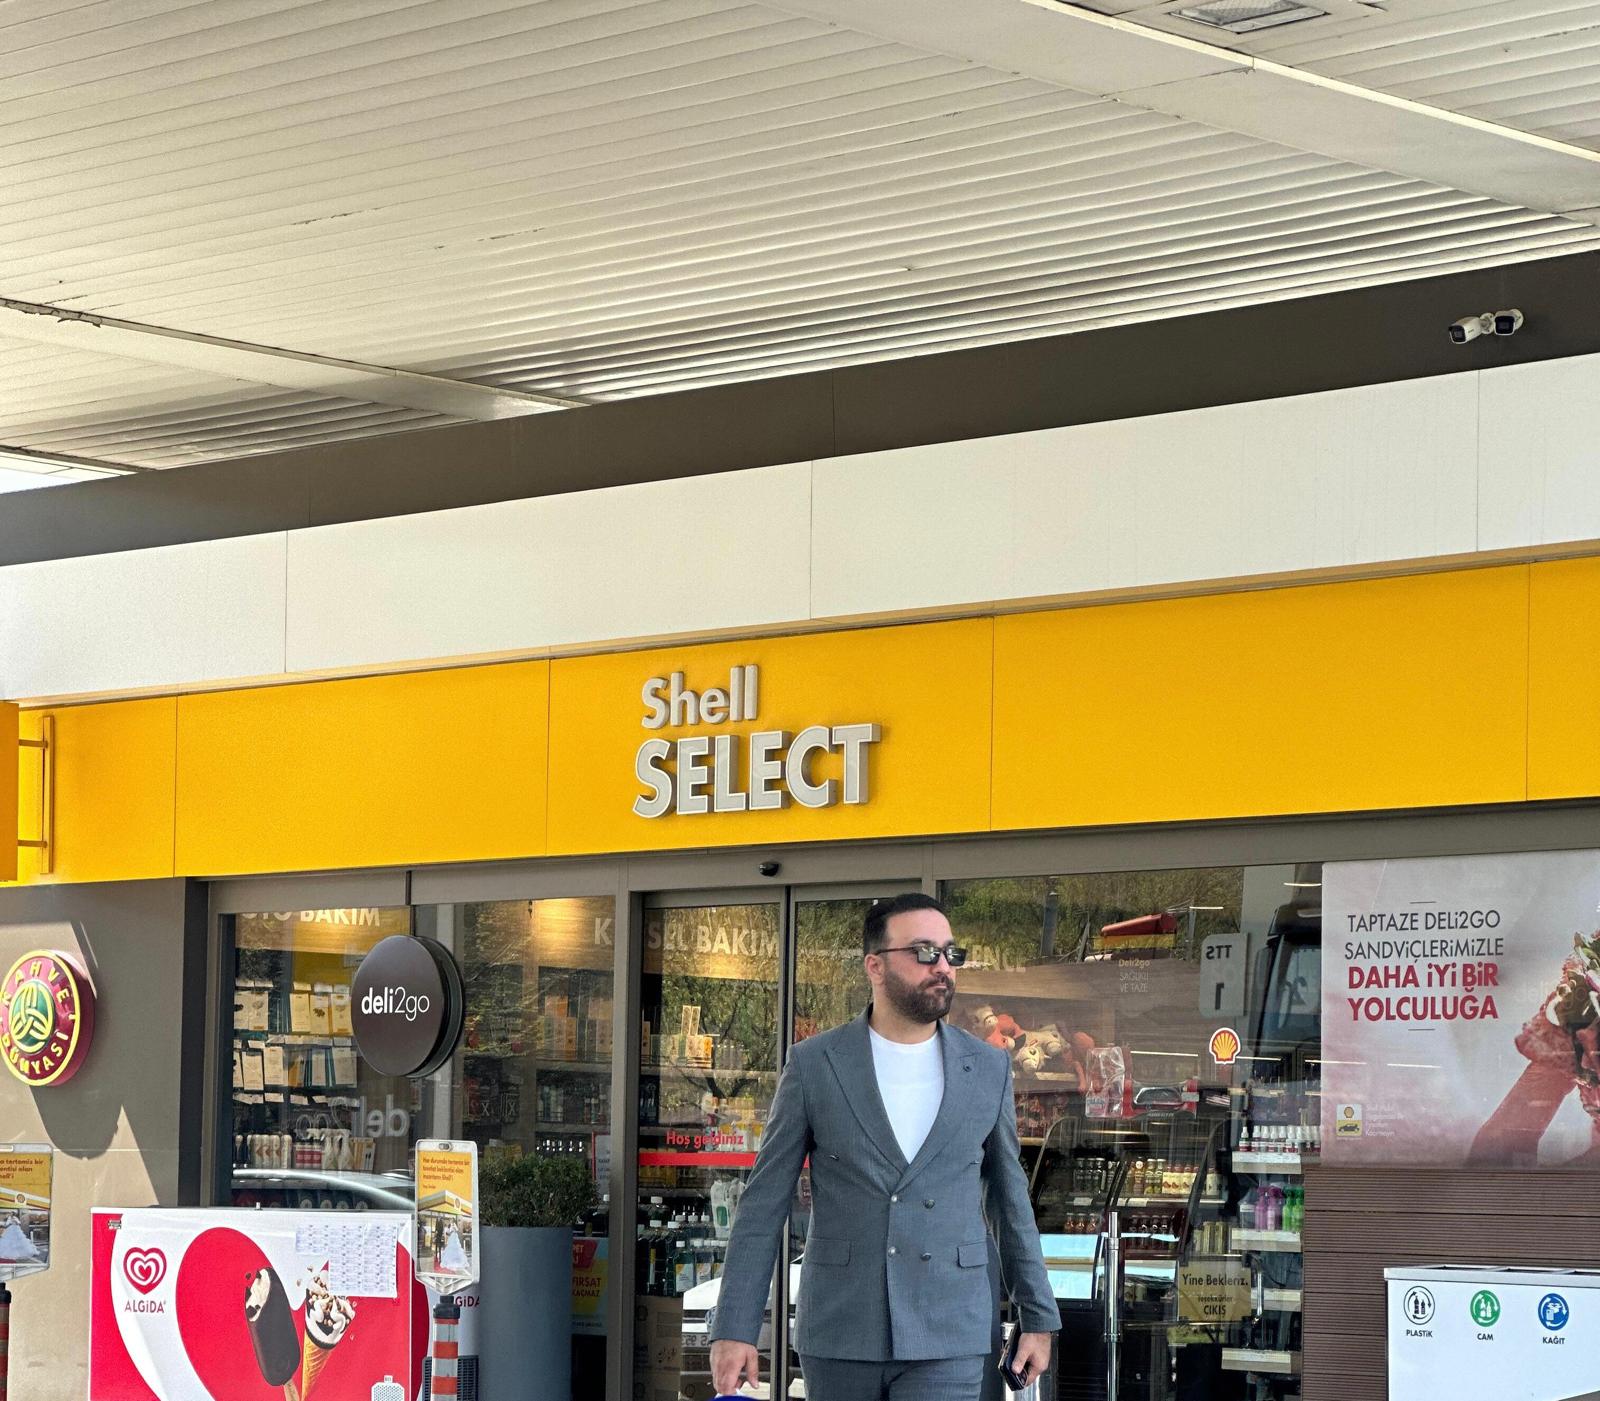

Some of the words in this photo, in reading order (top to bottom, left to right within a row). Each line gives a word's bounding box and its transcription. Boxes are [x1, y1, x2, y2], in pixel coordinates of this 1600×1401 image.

[641, 664, 758, 729] Shell
[632, 723, 882, 818] SELECT
[1347, 912, 1419, 932] TAPTAZE
[697, 925, 780, 957] BAKIM
[1348, 965, 1420, 989] DAHA
[361, 986, 430, 1021] deli2go
[1347, 987, 1499, 1021] YOLCULUĞA
[666, 1130, 690, 1149] Hoş
[1182, 1273, 1204, 1286] Yine
[1477, 1333, 1494, 1341] CAM
[1542, 1336, 1566, 1345] KAĞIT
